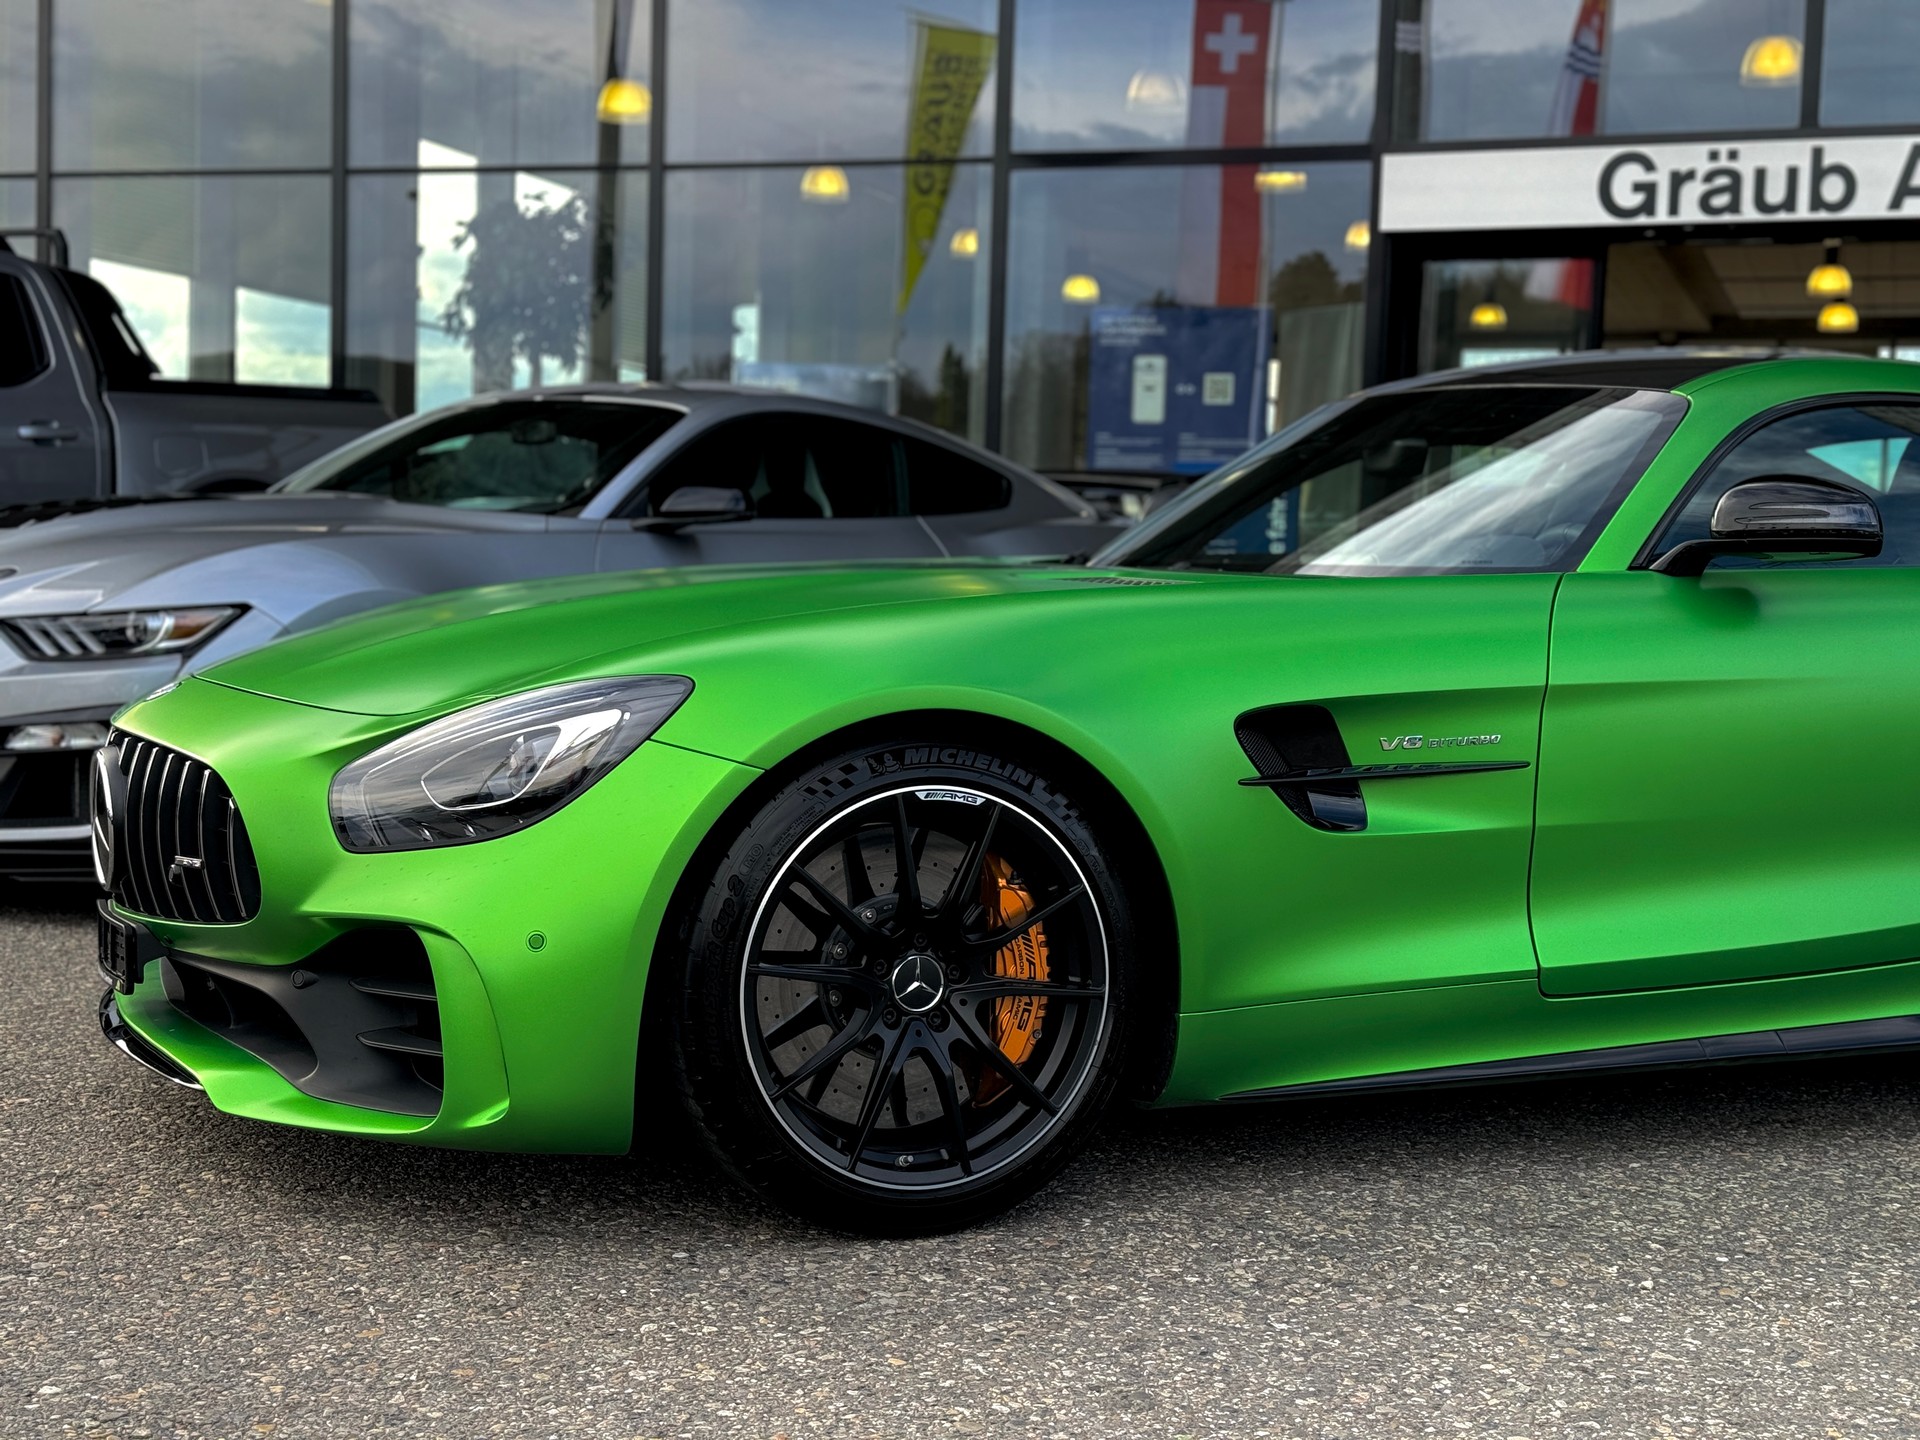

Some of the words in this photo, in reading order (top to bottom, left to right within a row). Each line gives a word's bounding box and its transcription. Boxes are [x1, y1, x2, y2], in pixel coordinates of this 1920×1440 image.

[1597, 146, 1857, 219] Gräub
[1379, 735, 1423, 751] V8
[1427, 734, 1501, 749] BITURBO
[903, 747, 1033, 787] MICHELIN
[941, 792, 978, 804] AMG
[711, 898, 736, 940] Cup
[1014, 938, 1026, 974] CARBON
